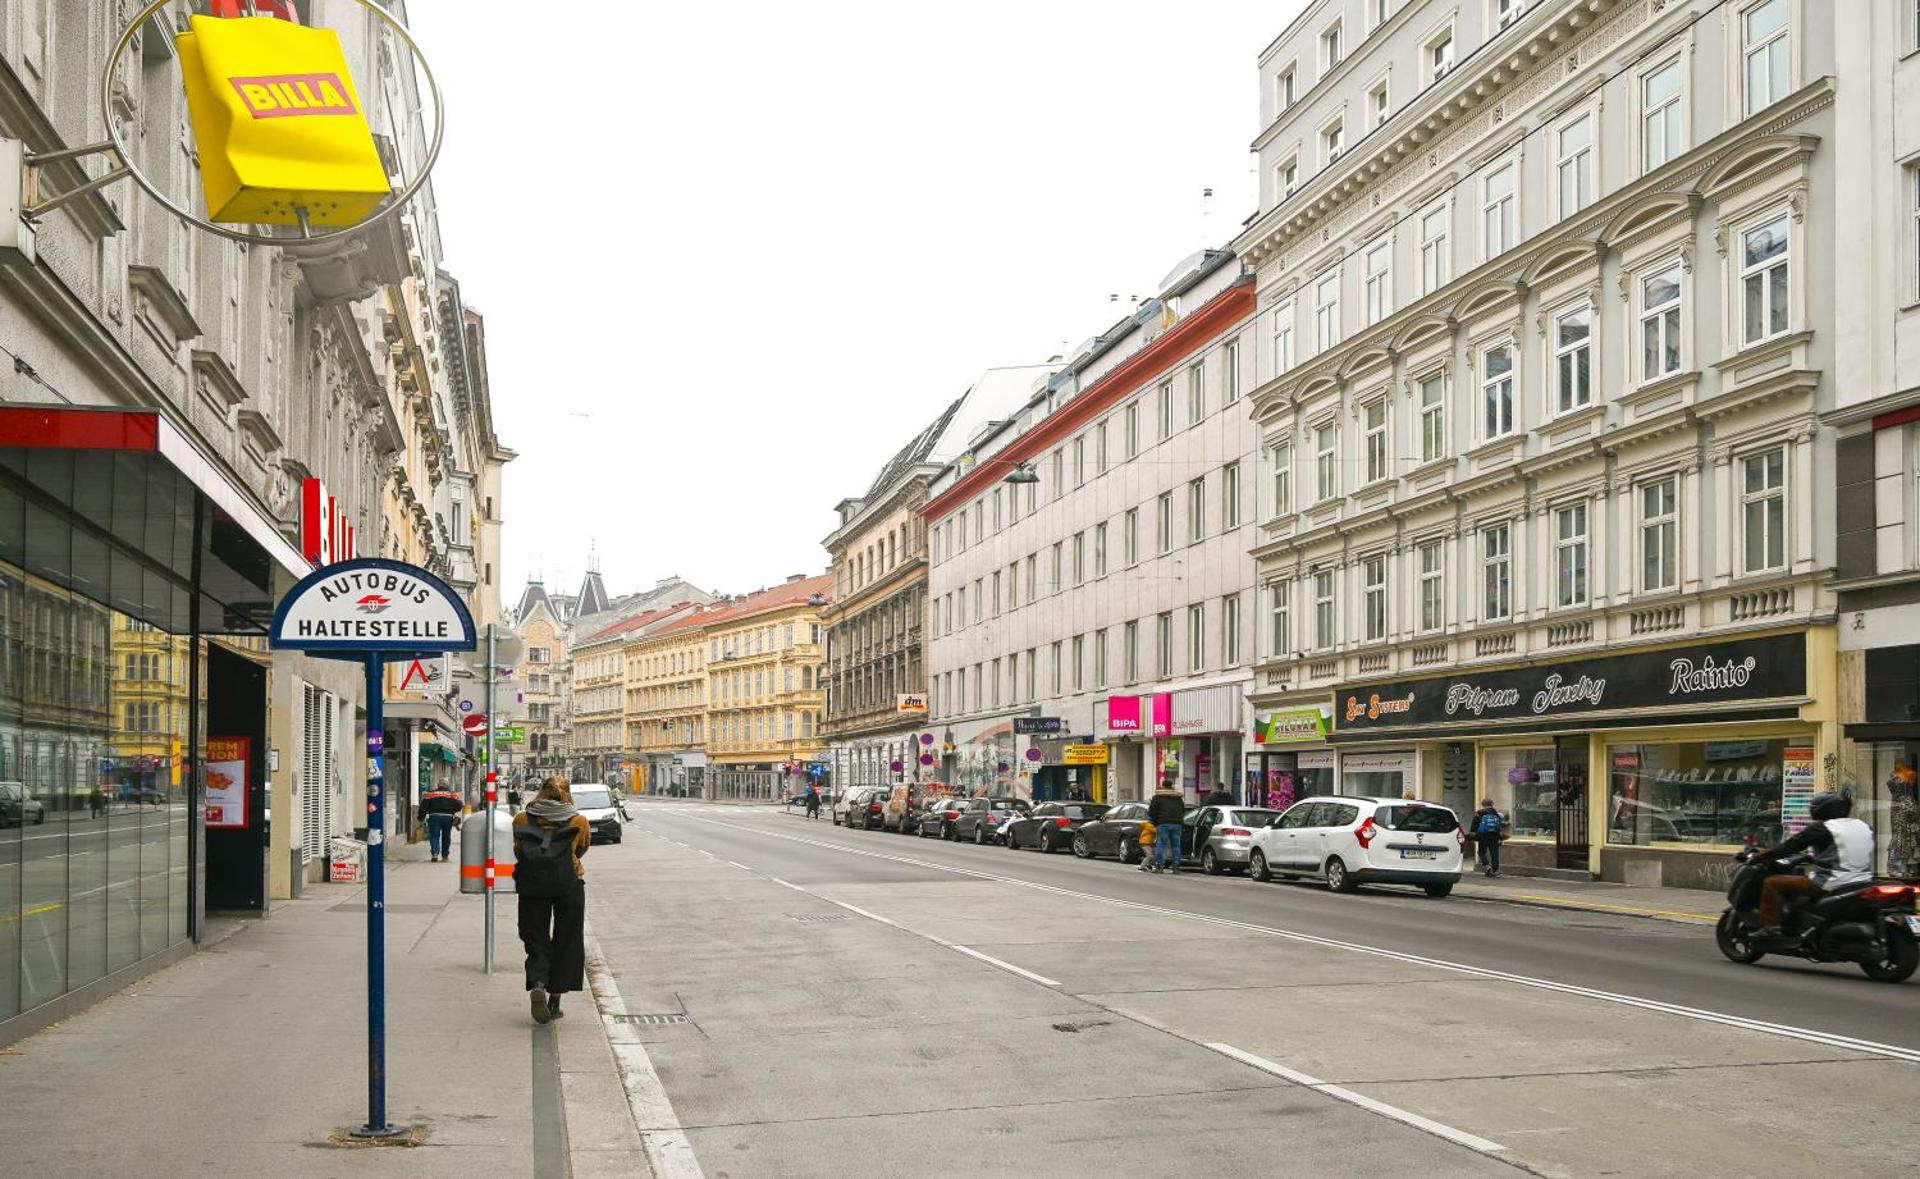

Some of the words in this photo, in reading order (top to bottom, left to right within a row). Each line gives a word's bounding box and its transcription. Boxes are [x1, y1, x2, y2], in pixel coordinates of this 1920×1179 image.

[240, 80, 348, 111] BILLA
[320, 572, 431, 604] AUTOBUS
[298, 620, 449, 638] HALTESTELLE
[904, 695, 922, 705] dm
[1445, 683, 1520, 716] Pilgram
[1532, 672, 1606, 714] Jewelry
[1112, 719, 1137, 728] BIPA
[207, 741, 239, 751] REM
